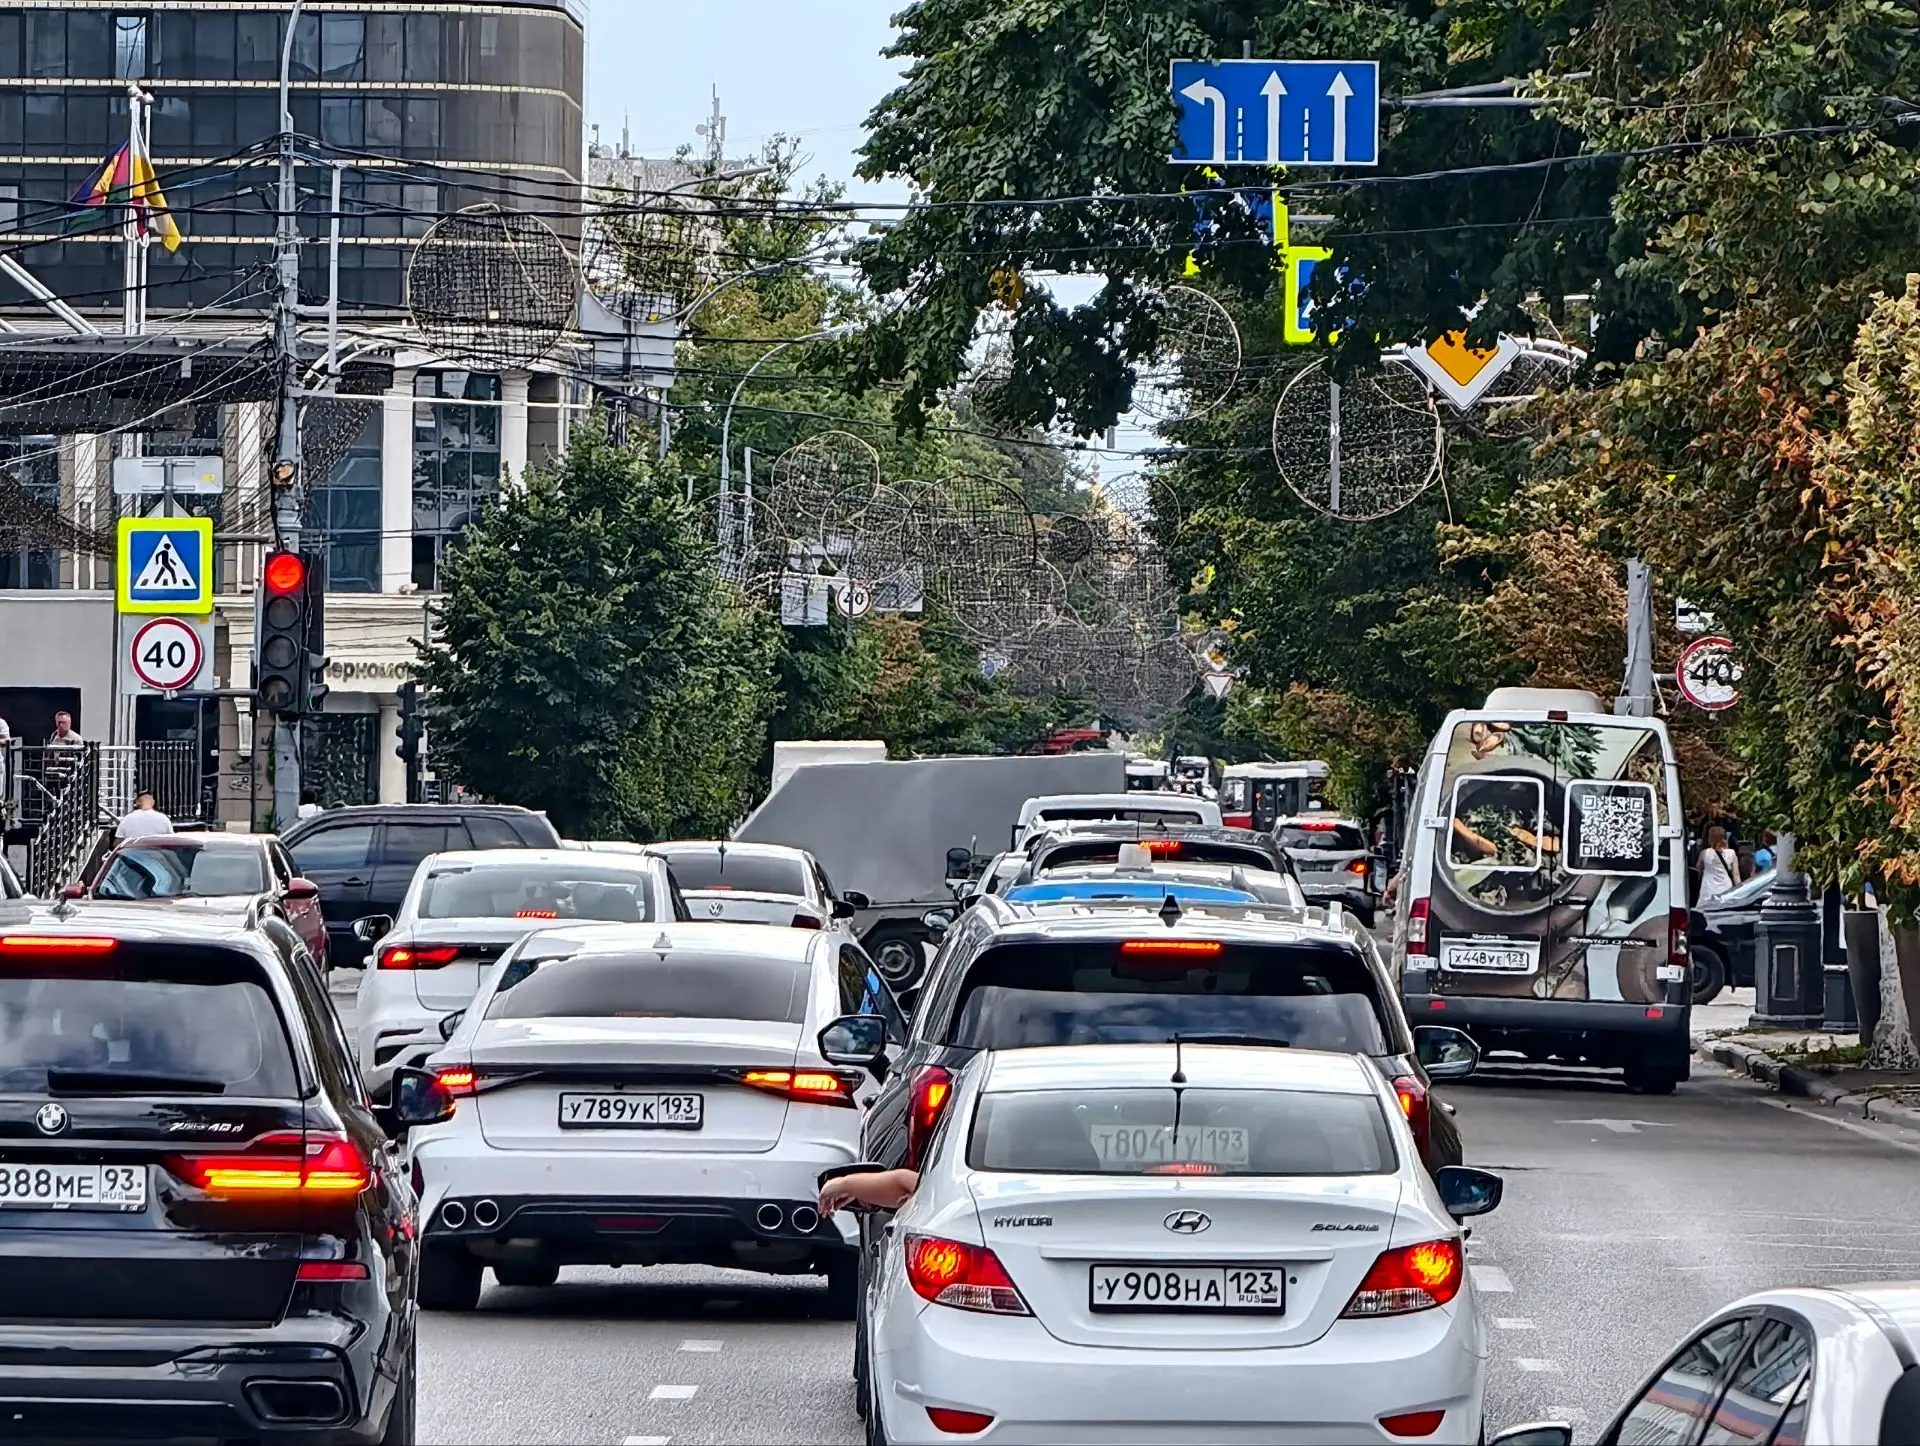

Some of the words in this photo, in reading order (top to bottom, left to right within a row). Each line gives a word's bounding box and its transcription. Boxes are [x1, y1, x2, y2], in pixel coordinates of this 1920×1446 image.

[143, 640, 186, 669] 40
[326, 661, 411, 682] ерномо
[1506, 952, 1524, 966] 123
[570, 1098, 655, 1120] У789УК
[661, 1096, 694, 1114] 193
[1206, 1129, 1244, 1159] 193
[104, 1168, 135, 1191] 93
[101, 1191, 125, 1200] RUS
[994, 1216, 1053, 1228] HYUNDAI
[1104, 1272, 1221, 1301] У908НА
[1228, 1271, 1273, 1294] 123
[1238, 1294, 1261, 1303] RUS
